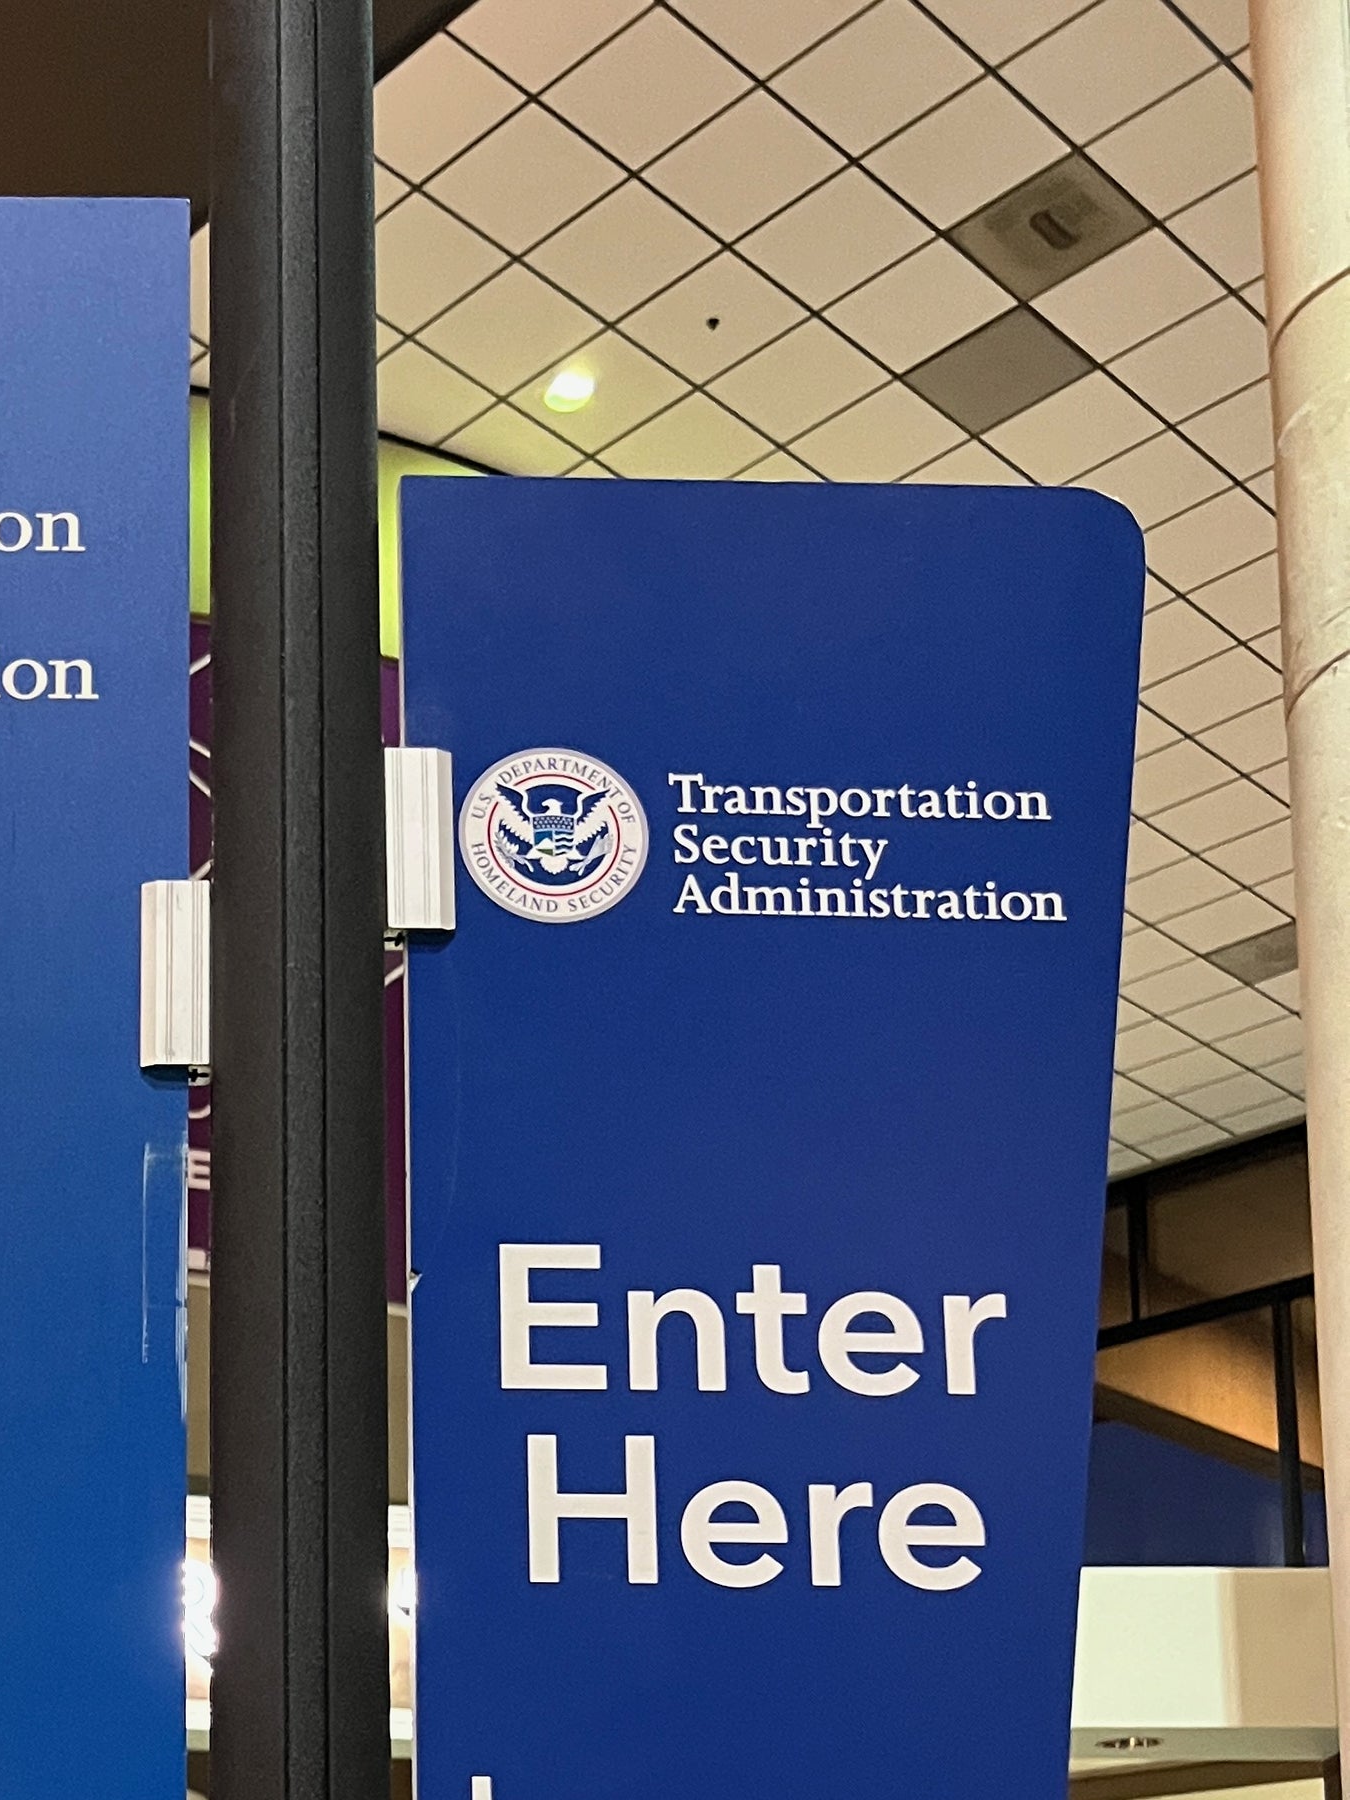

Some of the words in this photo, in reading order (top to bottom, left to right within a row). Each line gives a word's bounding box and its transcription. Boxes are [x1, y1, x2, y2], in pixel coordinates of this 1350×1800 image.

[471, 792, 495, 820] U.S.
[497, 757, 624, 802] DEPARTMENT
[617, 800, 637, 826] OF
[668, 772, 1052, 829] Transportation
[471, 842, 559, 914] HOMELAND
[568, 843, 638, 913] SECURITY
[673, 824, 889, 881] Security
[672, 871, 1068, 921] Administration
[498, 1243, 1007, 1397] Enter
[527, 1434, 986, 1591] Here
